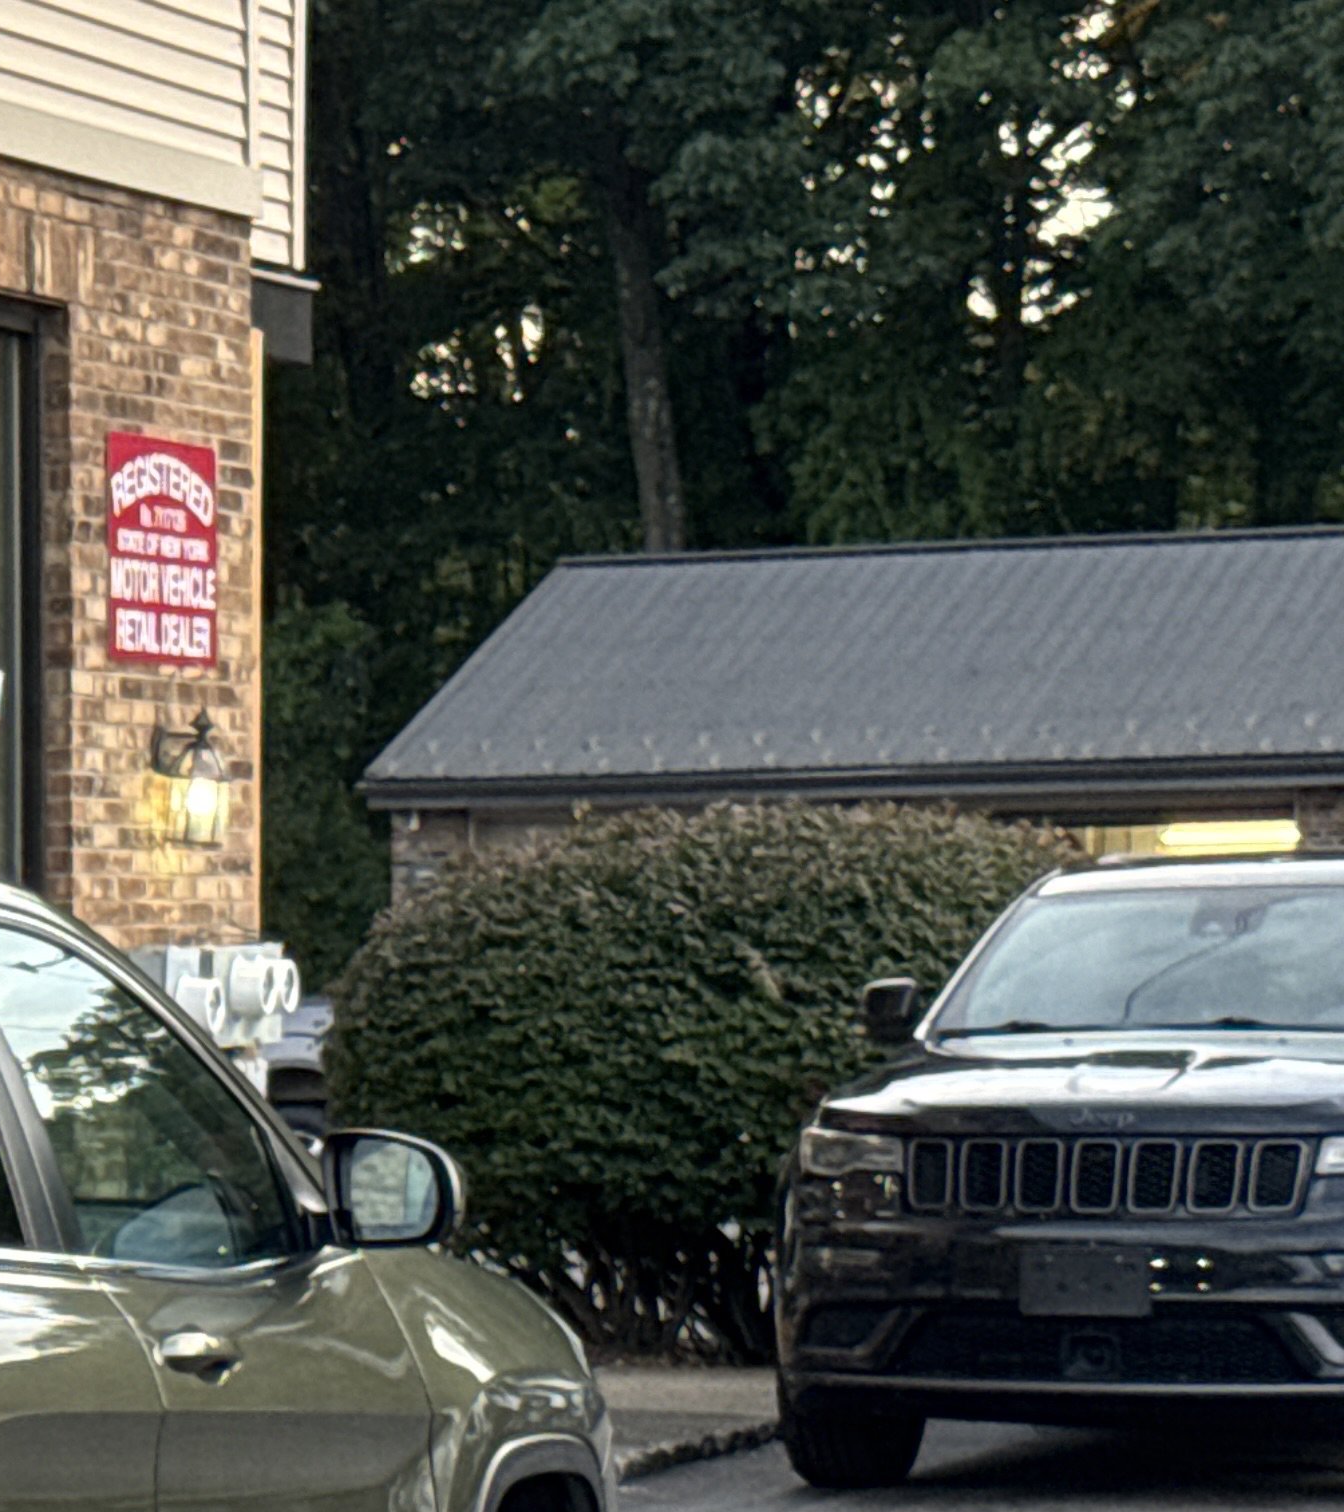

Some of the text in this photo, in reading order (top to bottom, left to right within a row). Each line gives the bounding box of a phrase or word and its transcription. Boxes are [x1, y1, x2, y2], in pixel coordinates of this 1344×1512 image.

[110, 452, 213, 527] REGISTERED
[111, 558, 216, 609] MOTOR VEHICLE
[116, 607, 210, 658] RETAIL DEALER
